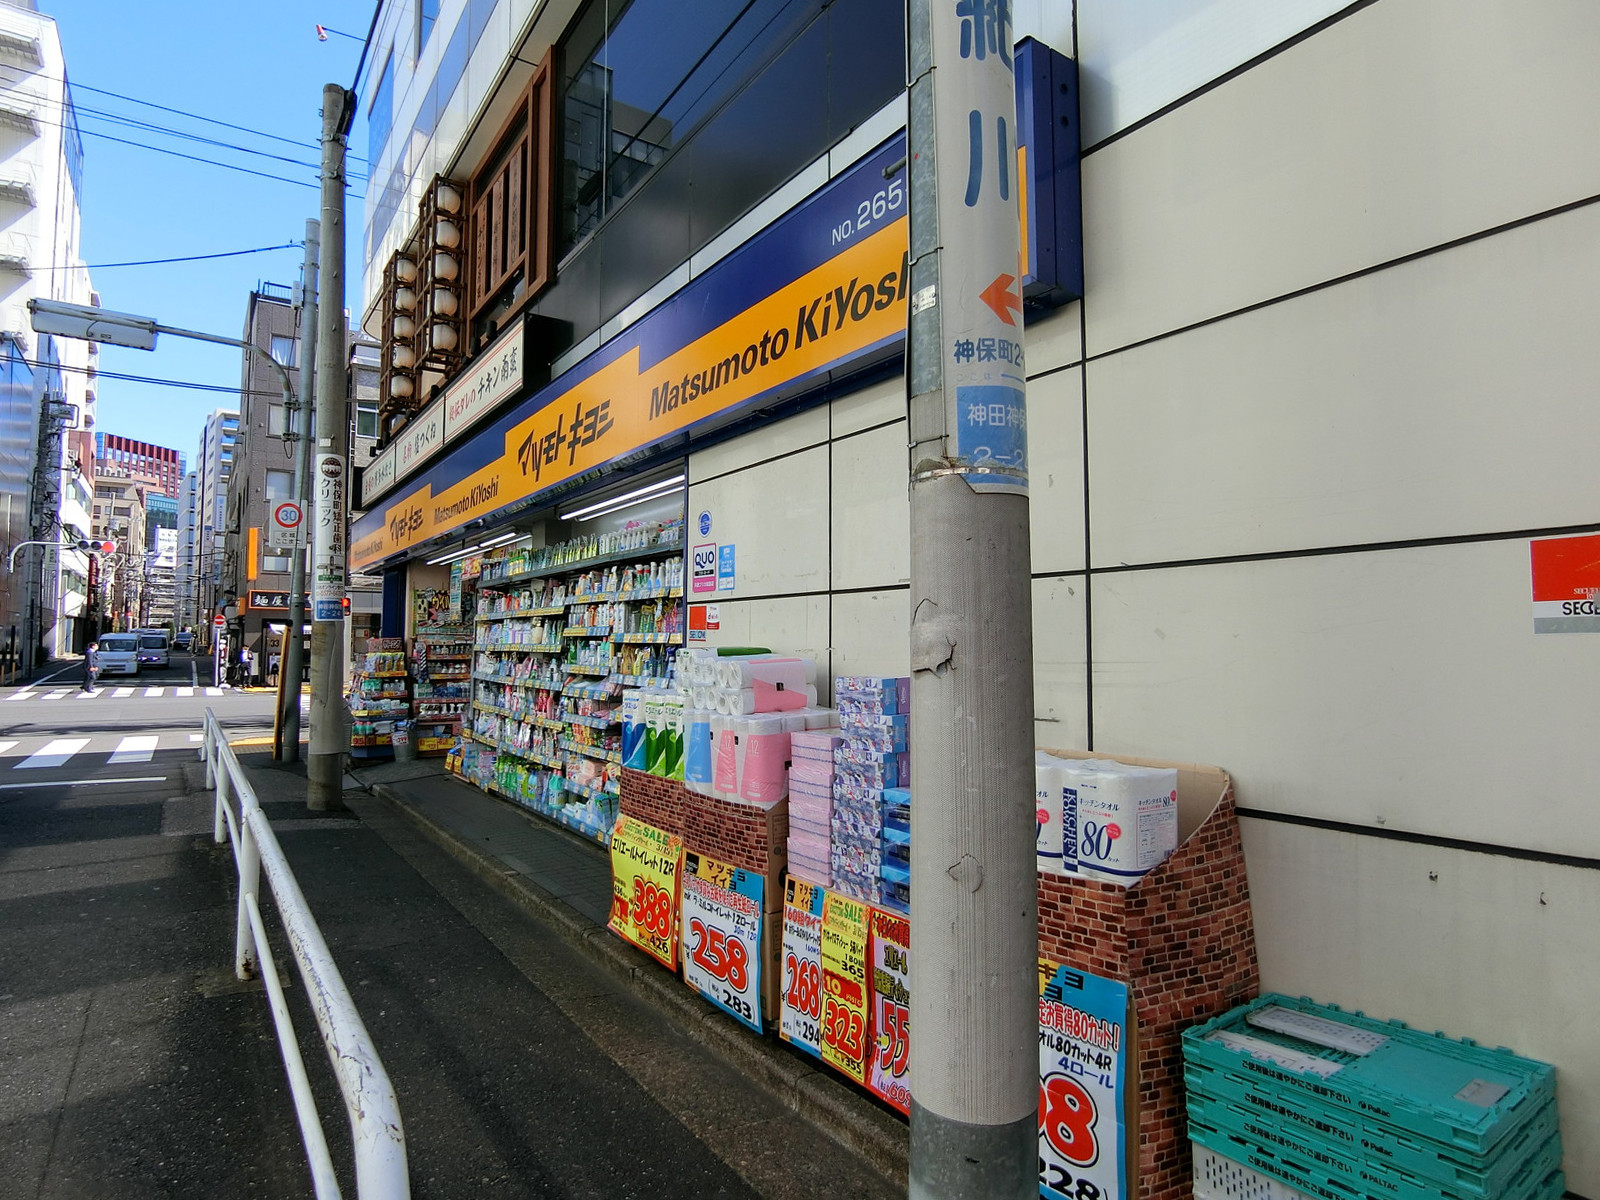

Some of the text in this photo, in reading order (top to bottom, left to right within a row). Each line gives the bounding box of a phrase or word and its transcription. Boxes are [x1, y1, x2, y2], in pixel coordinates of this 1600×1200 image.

[649, 327, 789, 420] Matsumoto
[517, 399, 614, 482] マツモトキヨシ
[320, 478, 331, 527] クリニック
[434, 475, 499, 526] Matsumoto KiYoshi
[280, 510, 297, 521] 30
[333, 478, 342, 554] 神保町矯正歯科
[695, 551, 714, 569] QUO
[750, 739, 759, 755] 12
[1080, 797, 1120, 812] キッチンタオル
[642, 826, 670, 846] SALE
[1081, 821, 1112, 861] 80
[706, 860, 746, 882] マツキヨ
[711, 874, 737, 891] イイヨ
[799, 883, 819, 901] マツキヨ
[633, 875, 673, 941] 388
[800, 898, 814, 911] イイヨ
[844, 902, 863, 925] SALE
[649, 935, 669, 954] 426
[690, 917, 749, 994] 258
[841, 960, 864, 979] 365
[786, 952, 821, 1021] 268
[723, 988, 752, 1020] 283
[802, 1021, 820, 1046] 294
[824, 998, 865, 1063] 323
[881, 997, 911, 1077] 55
[845, 1056, 862, 1075] 355
[1058, 1056, 1114, 1090] 4ロール
[1038, 1072, 1099, 1168] 8
[1367, 1103, 1391, 1118] Paltac
[1370, 1142, 1393, 1158] Paltac
[1247, 1154, 1347, 1200] ご使用後は速やかにご返却下
[1369, 1174, 1398, 1193] PALTAC
